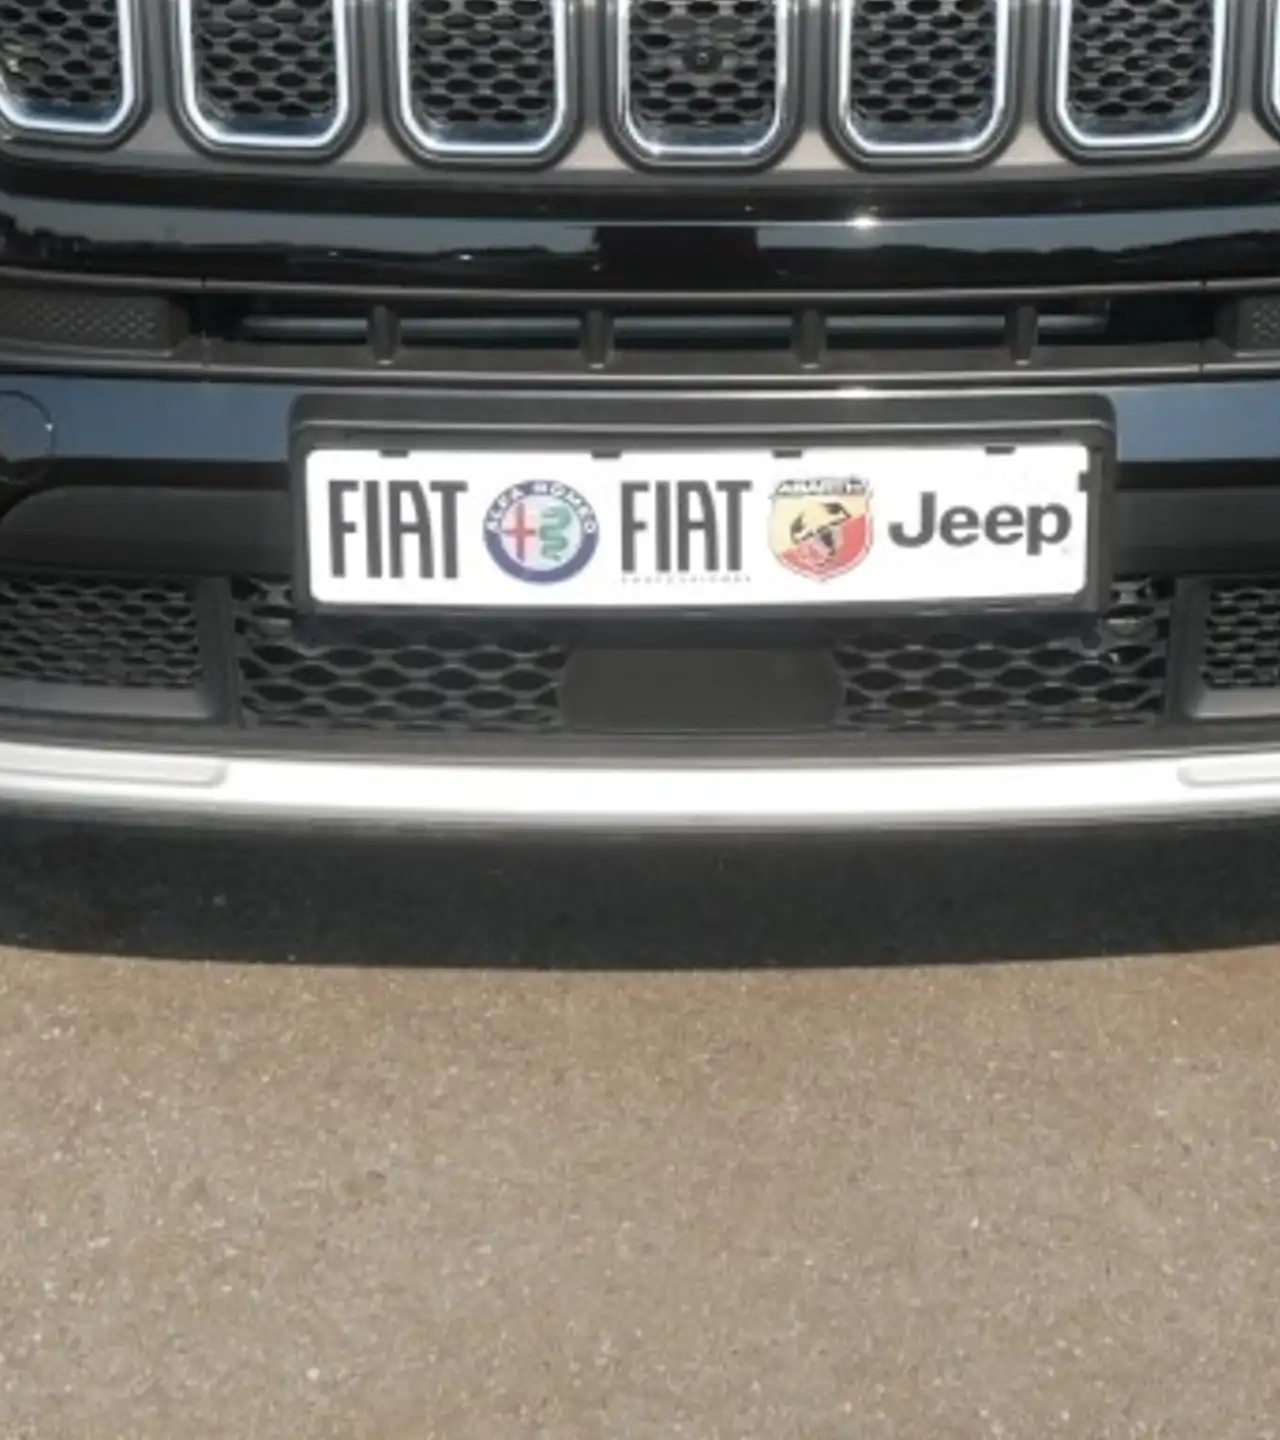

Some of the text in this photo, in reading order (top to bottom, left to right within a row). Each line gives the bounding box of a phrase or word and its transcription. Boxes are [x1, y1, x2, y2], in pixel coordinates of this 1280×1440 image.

[329, 480, 468, 578] FIAT
[485, 482, 597, 534] ALFA ROMEO
[620, 480, 753, 571] FIAT
[888, 491, 1072, 555] Jeep
